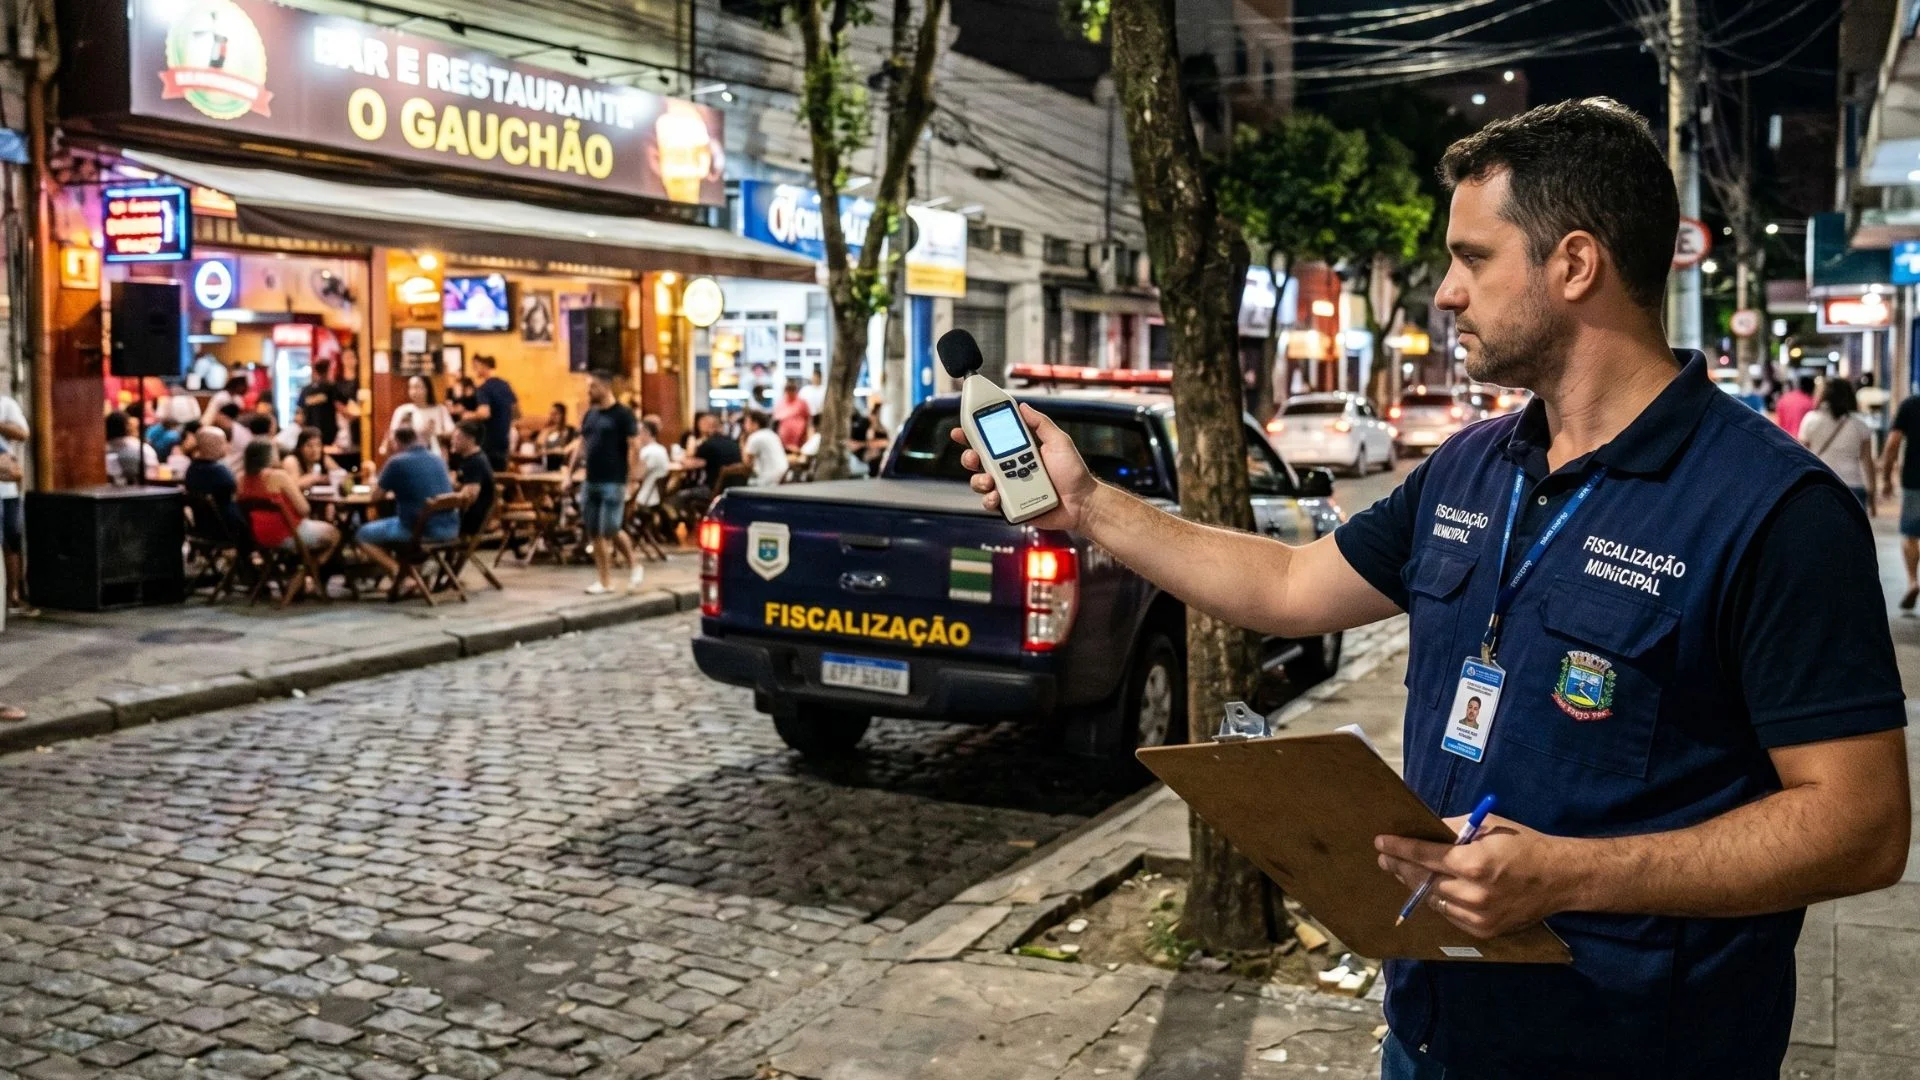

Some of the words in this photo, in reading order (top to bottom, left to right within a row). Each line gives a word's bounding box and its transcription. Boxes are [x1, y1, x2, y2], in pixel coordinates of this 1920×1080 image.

[314, 26, 390, 79] BAR
[397, 45, 420, 86] E
[427, 52, 636, 129] RESTAURANTE
[347, 87, 387, 140] O
[400, 97, 613, 180] GAUCHÃO
[1677, 228, 1697, 254] E
[1582, 535, 1687, 579] FISCALIZAÇÃO
[765, 602, 971, 647] FISCALIZAÇÃO
